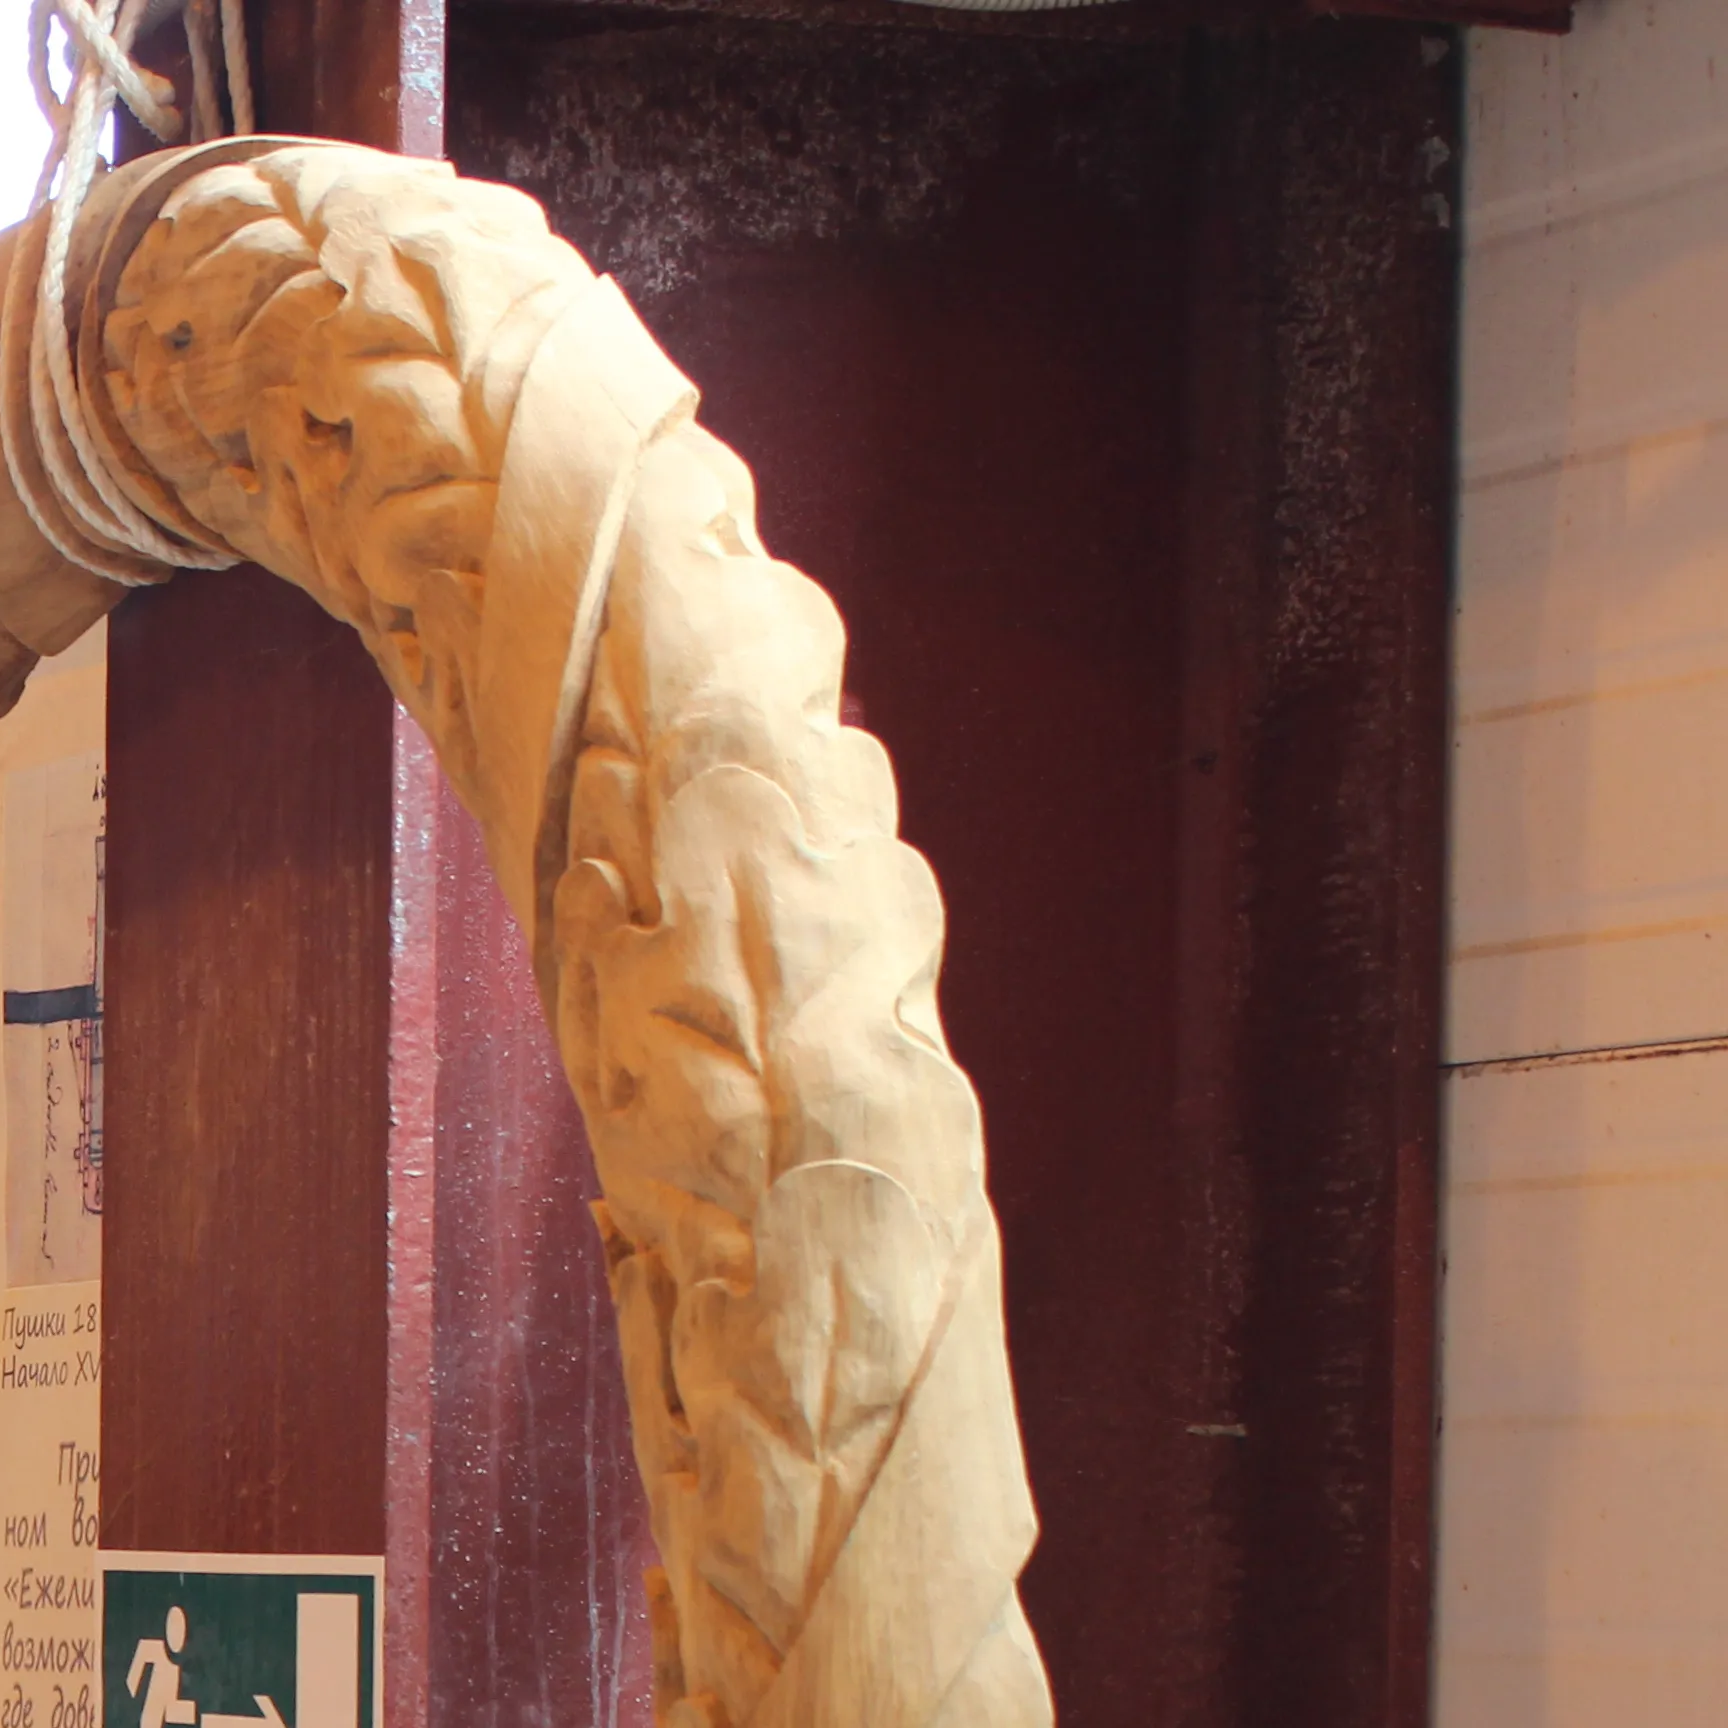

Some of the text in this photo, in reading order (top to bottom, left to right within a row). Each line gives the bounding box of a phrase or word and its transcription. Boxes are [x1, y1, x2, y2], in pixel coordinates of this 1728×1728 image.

[2, 1306, 66, 1350] Пушки
[1, 1354, 69, 1390] Начало
[4, 1512, 48, 1549] ном
